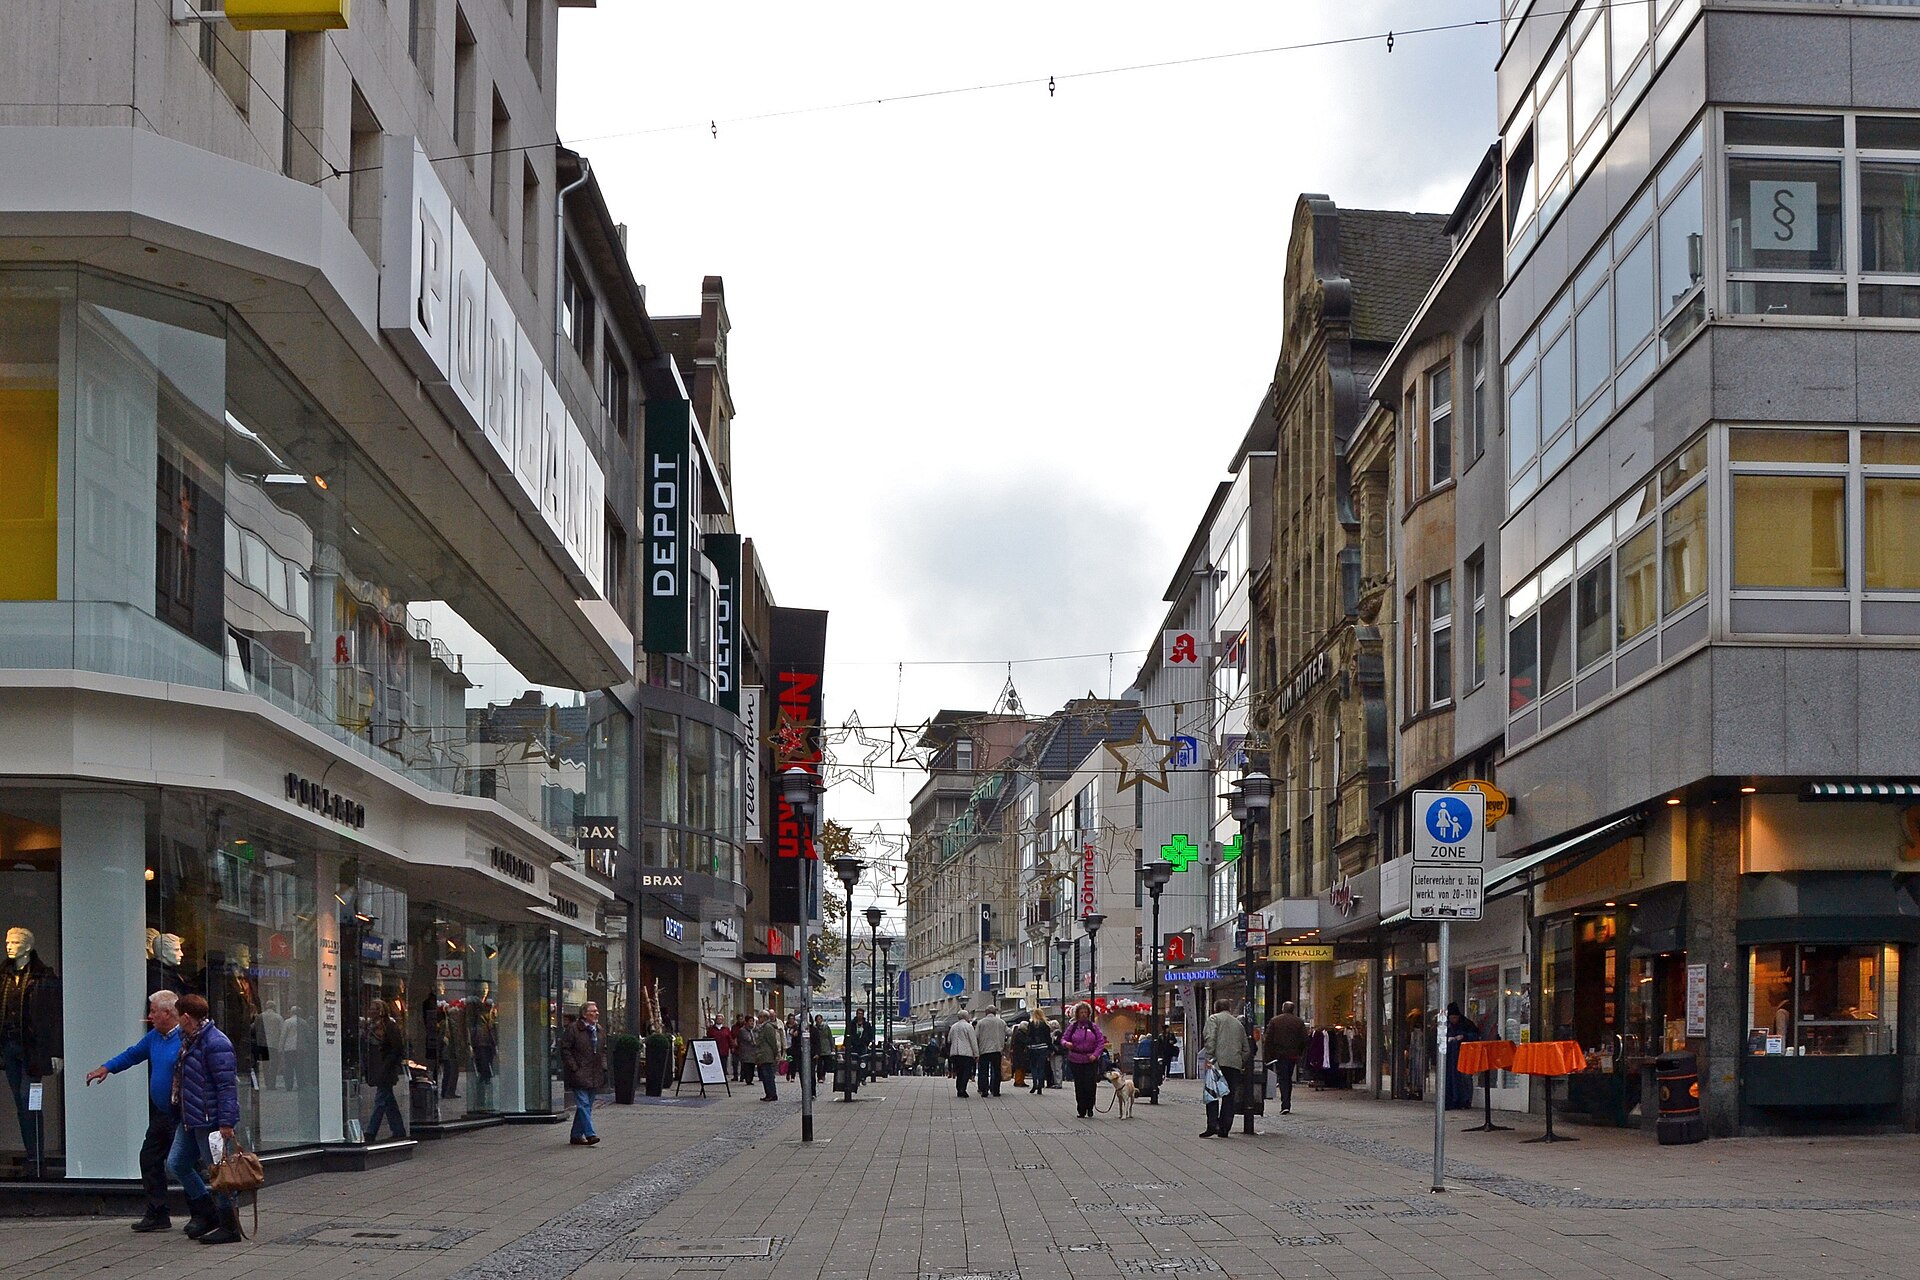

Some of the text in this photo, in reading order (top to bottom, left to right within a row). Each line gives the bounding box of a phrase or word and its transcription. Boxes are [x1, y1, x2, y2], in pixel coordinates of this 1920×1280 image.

[418, 196, 601, 582] POHLAND
[652, 453, 677, 597] DEPOT
[1296, 652, 1324, 701] RITTER
[1431, 846, 1466, 858] ZONE
[642, 875, 683, 886] BRAX
[1414, 875, 1480, 886] Lieferverkehr u. Taxi
[1416, 889, 1435, 900] werkt.
[1438, 892, 1450, 900] von
